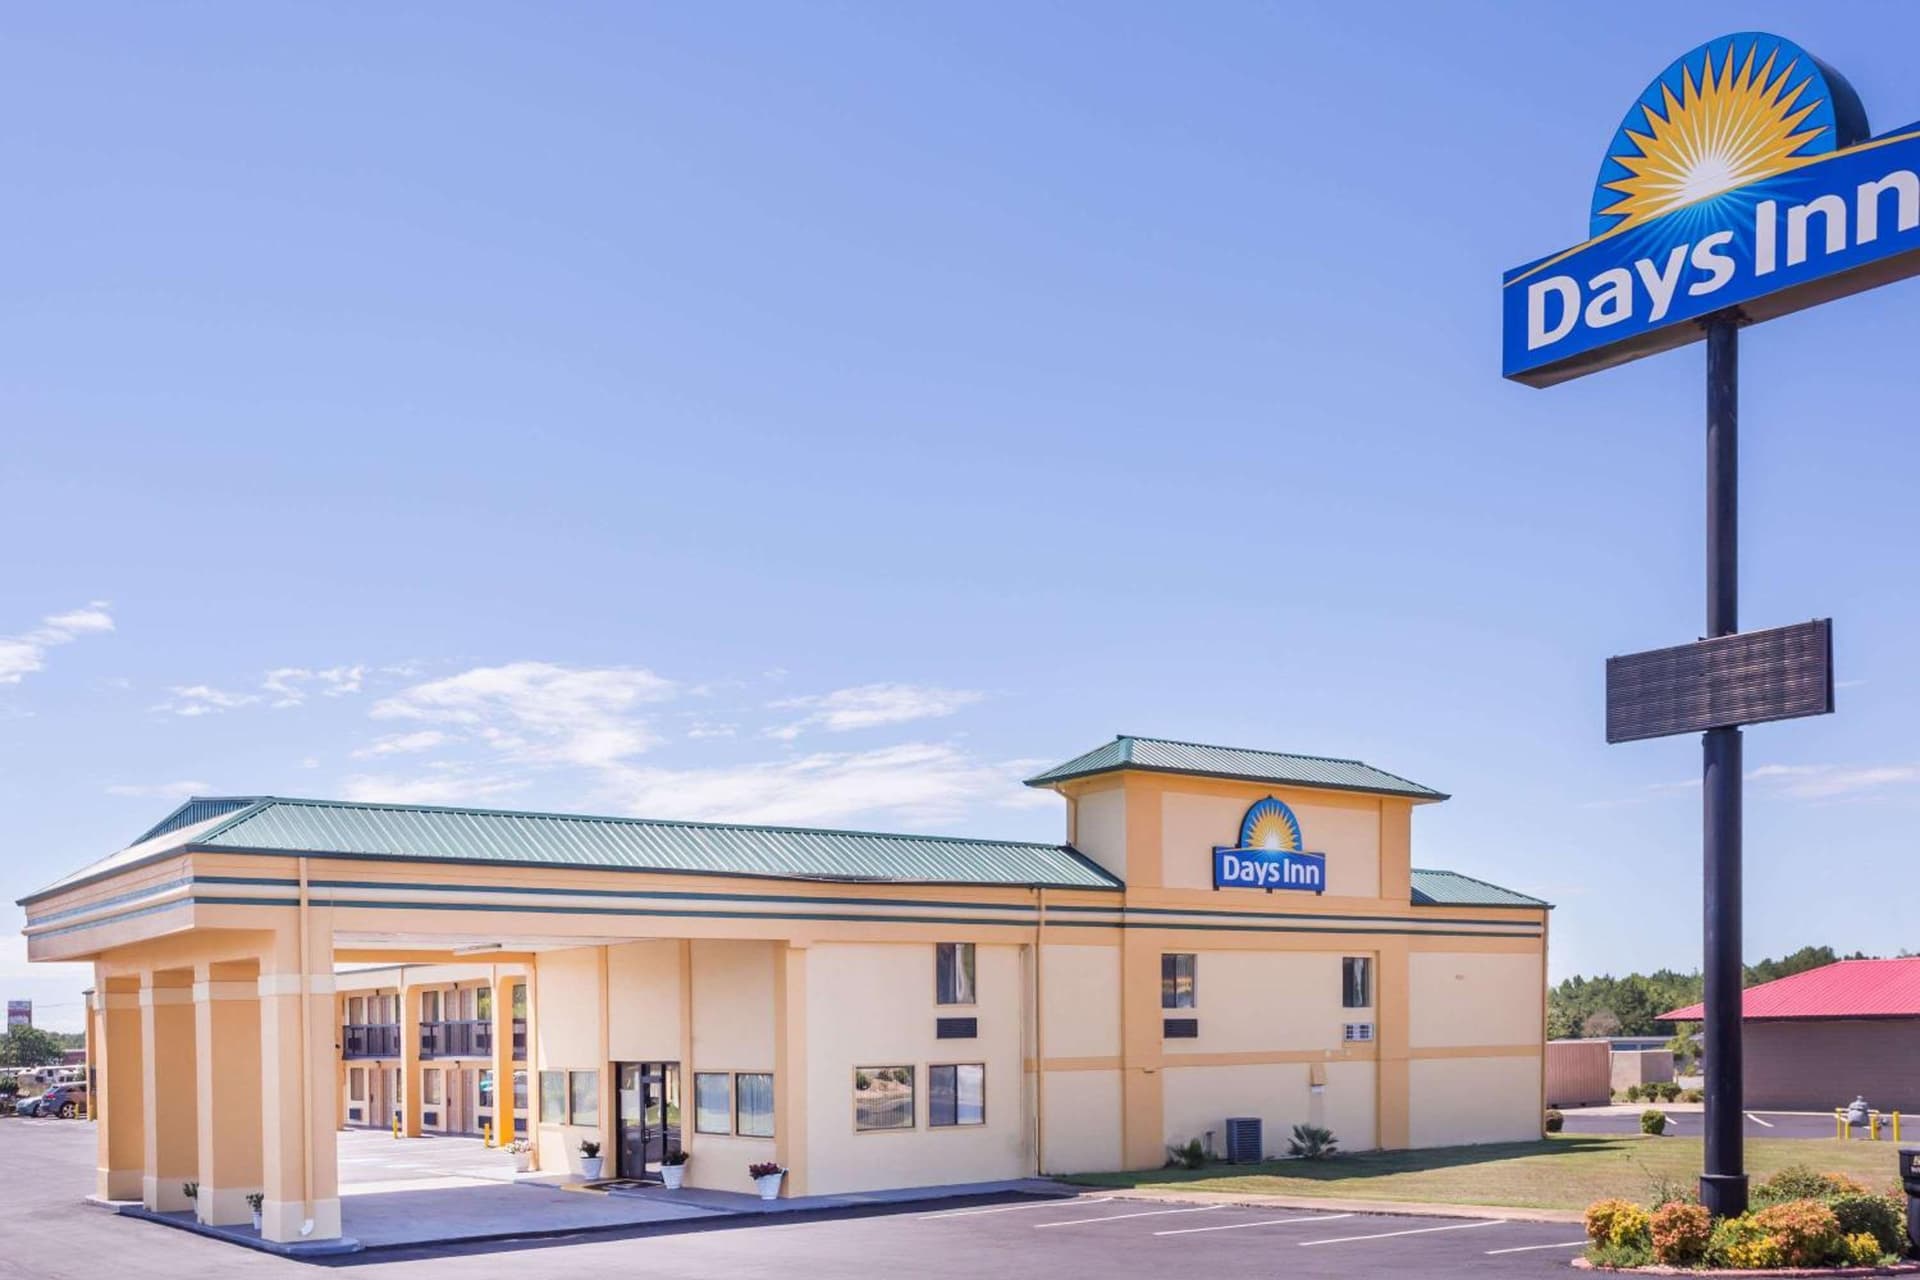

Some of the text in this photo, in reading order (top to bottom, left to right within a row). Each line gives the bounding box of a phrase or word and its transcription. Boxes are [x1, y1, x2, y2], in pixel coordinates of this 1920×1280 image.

[1527, 170, 1919, 351] Days Inn
[1223, 855, 1319, 885] Days Inn
